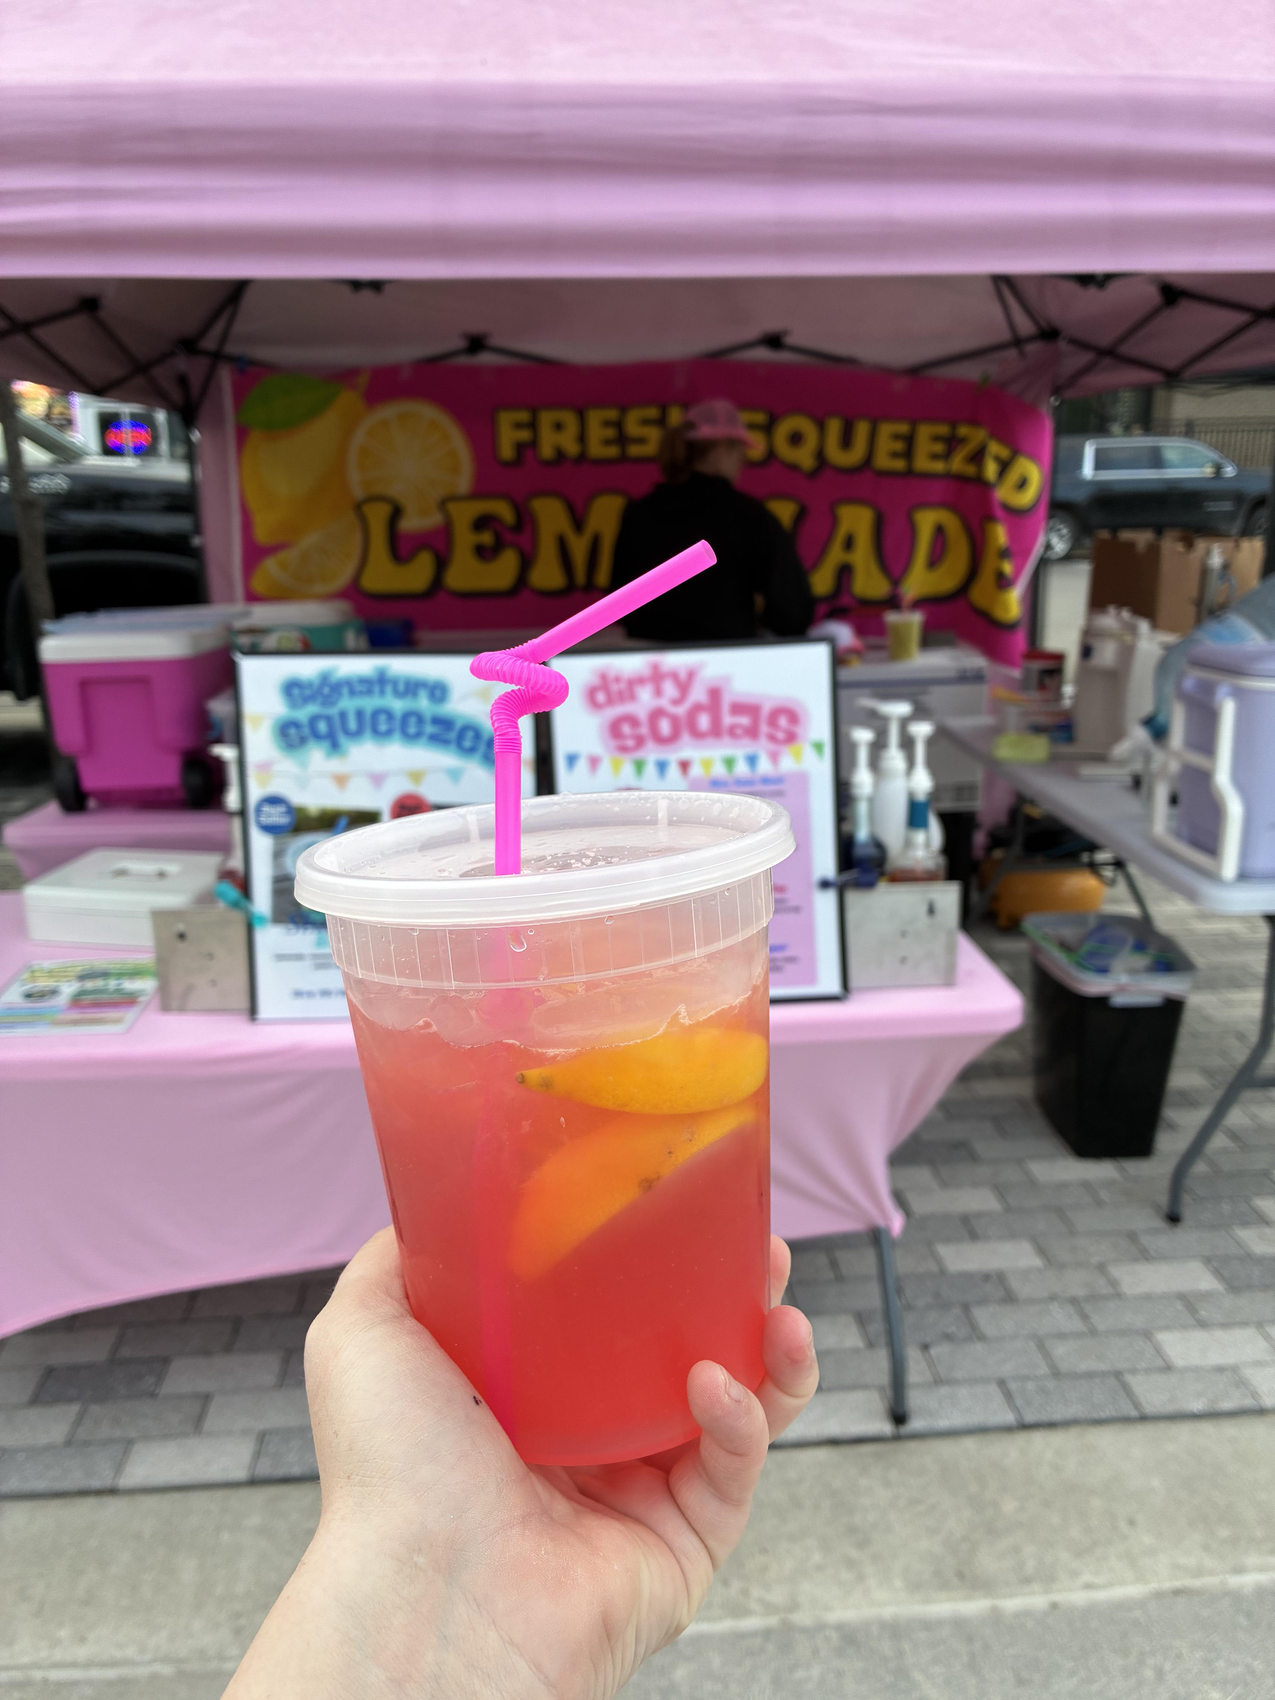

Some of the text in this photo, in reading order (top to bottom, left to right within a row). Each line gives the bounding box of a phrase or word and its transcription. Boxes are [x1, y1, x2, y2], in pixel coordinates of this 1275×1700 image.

[738, 411, 1043, 513] SQUEEZED
[357, 492, 1022, 629] LEMADE
[586, 660, 697, 709] dirty
[608, 686, 801, 754] sodas
